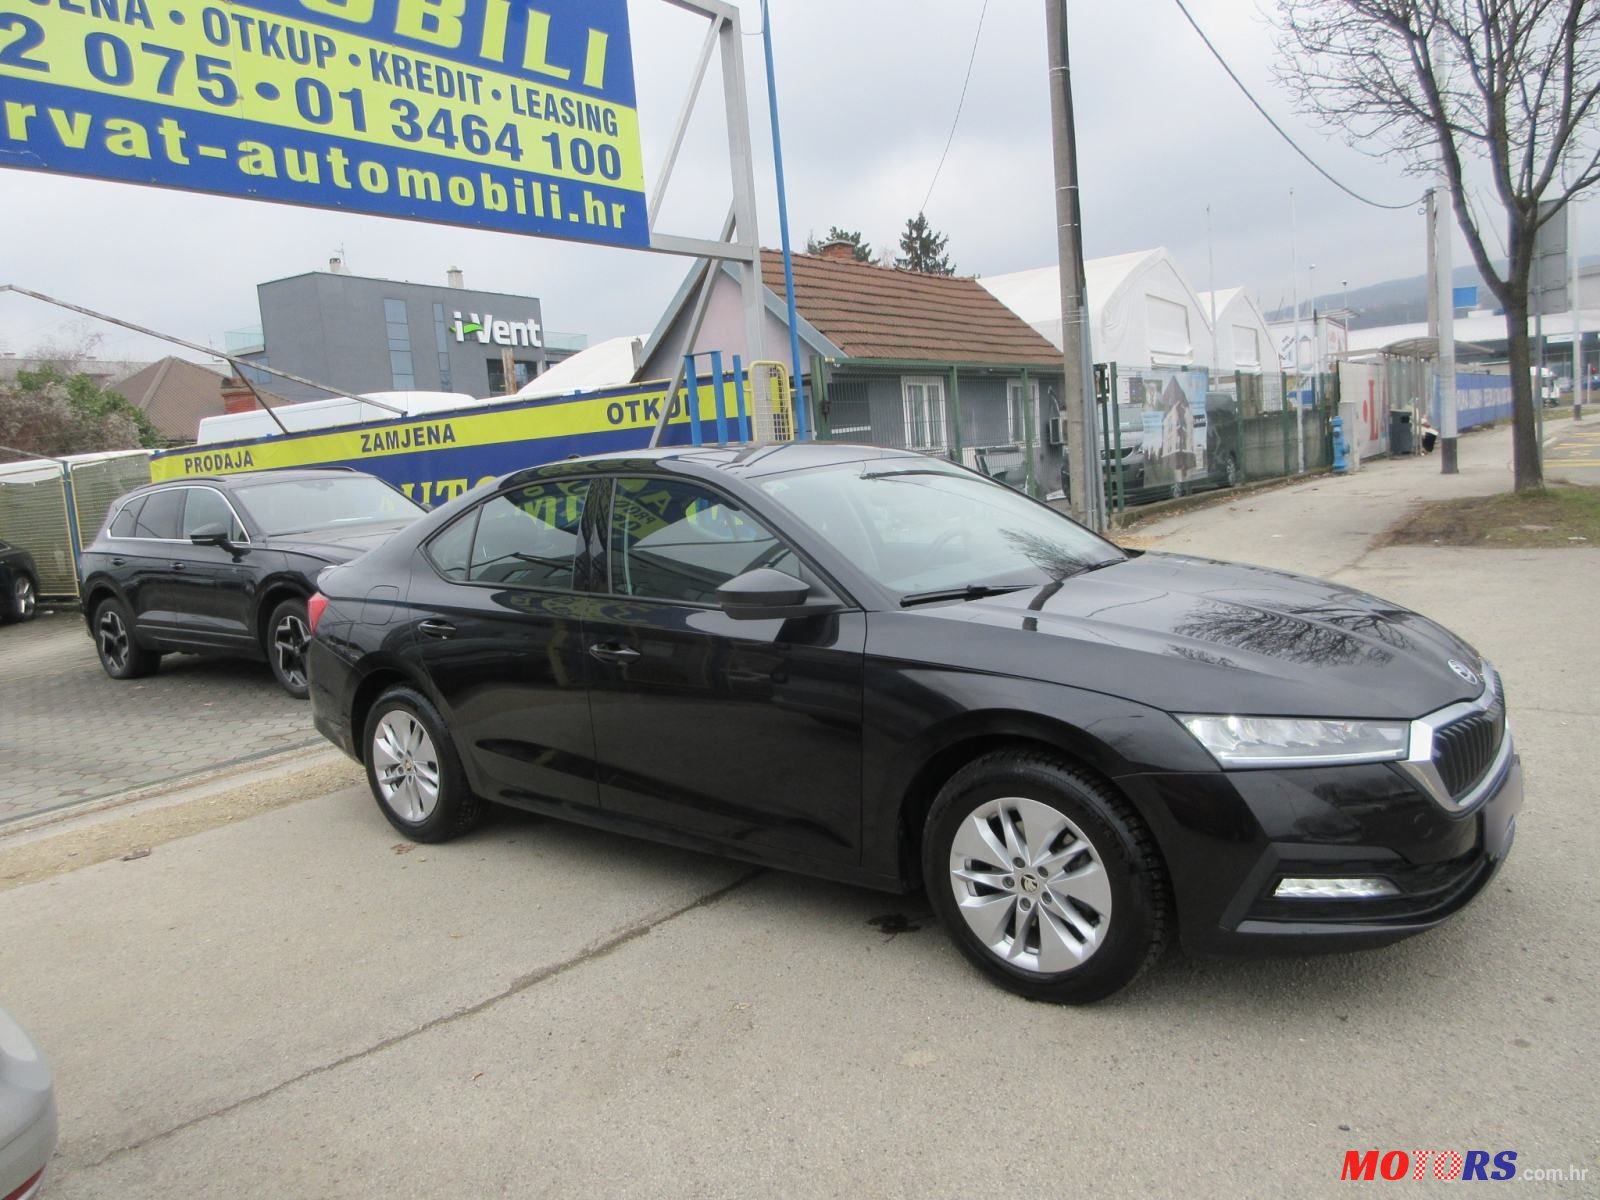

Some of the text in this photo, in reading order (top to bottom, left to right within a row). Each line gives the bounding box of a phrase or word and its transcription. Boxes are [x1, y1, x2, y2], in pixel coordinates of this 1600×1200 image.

[84, 31, 238, 107] 075
[295, 77, 367, 133] 01
[390, 98, 523, 162] 3464
[542, 132, 622, 181] 100
[203, 7, 336, 69] OTKUP
[369, 48, 483, 105] KREDIT
[510, 84, 618, 137] LEASING
[4, 101, 626, 229] rvat-automobili.hr
[185, 423, 456, 474] PRODAJA ZAMJENA
